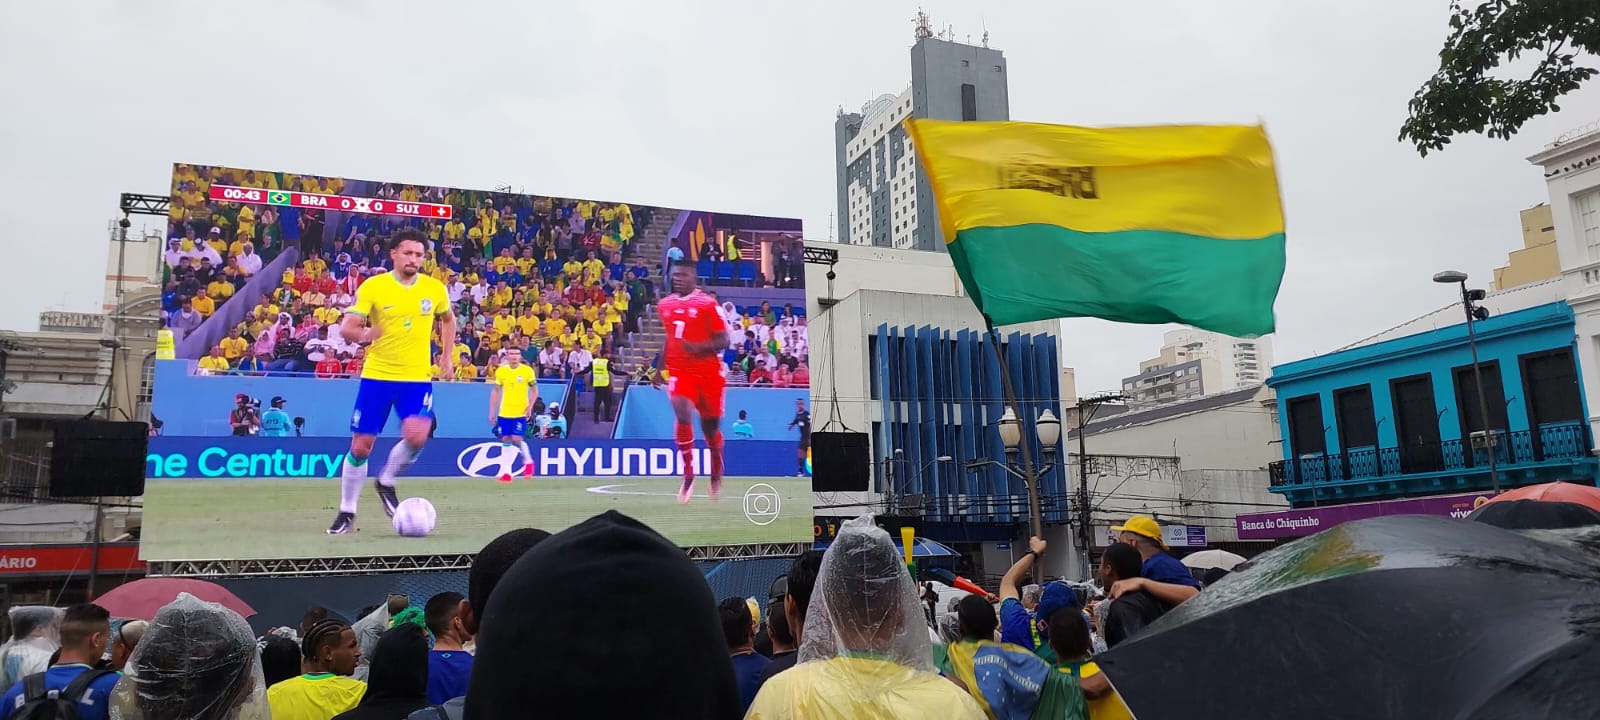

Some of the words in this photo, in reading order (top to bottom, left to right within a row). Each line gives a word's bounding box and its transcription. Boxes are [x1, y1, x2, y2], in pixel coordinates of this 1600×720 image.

[223, 188, 260, 200] 00:43
[301, 195, 328, 206] BRA
[341, 199, 350, 209] 0
[374, 202, 383, 212] 0
[396, 204, 419, 215] SUI
[198, 446, 344, 479] Century
[1242, 520, 1265, 530] Banca
[1265, 519, 1275, 529] do
[1276, 516, 1320, 530] Chiquinho
[0, 555, 37, 569] ÁRIO
